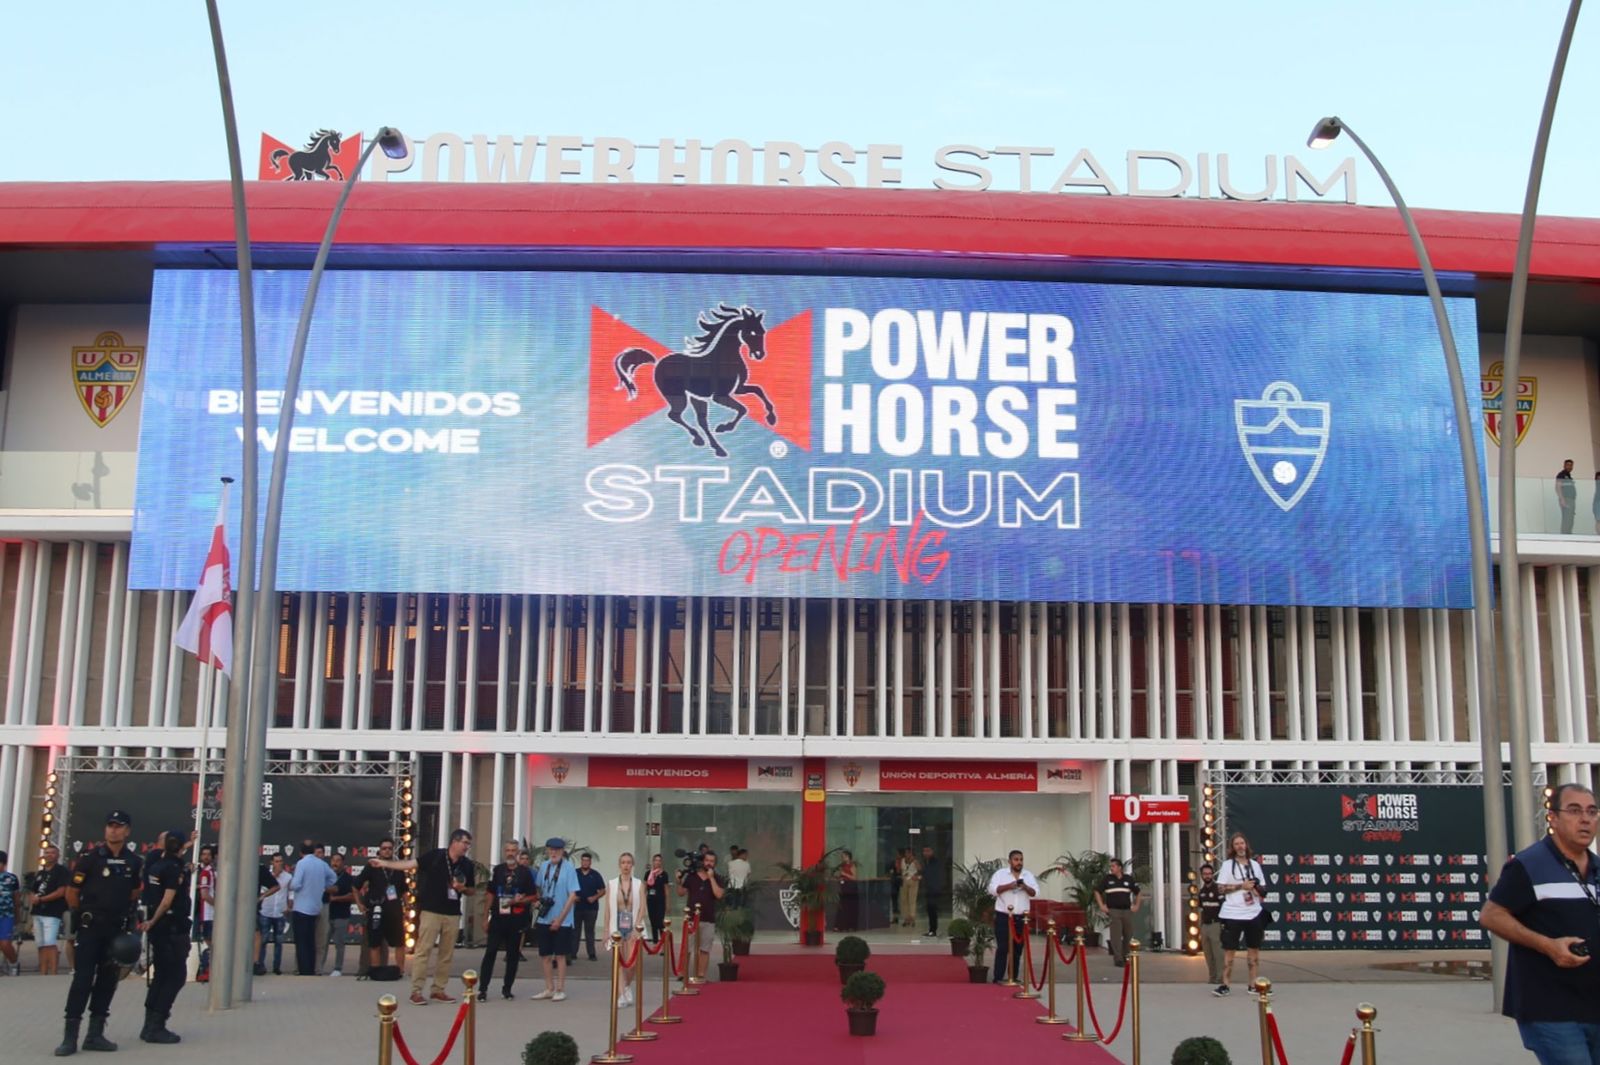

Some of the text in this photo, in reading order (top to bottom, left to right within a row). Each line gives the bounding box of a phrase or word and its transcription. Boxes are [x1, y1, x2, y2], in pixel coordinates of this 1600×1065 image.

[371, 132, 1357, 205] POWER HORSE STADIUM
[823, 307, 1077, 383] POWER
[82, 353, 134, 365] U D
[207, 389, 521, 416] BENVENIDOS
[822, 383, 1079, 459] HORSE
[582, 463, 1081, 529] STADIUM
[717, 507, 951, 585] OPENING
[626, 769, 709, 777] BIENVENIDOS
[1124, 796, 1140, 821] 0
[1377, 794, 1417, 806] POWER
[1377, 806, 1418, 819] HORSE
[1342, 820, 1419, 831] STADIUM
